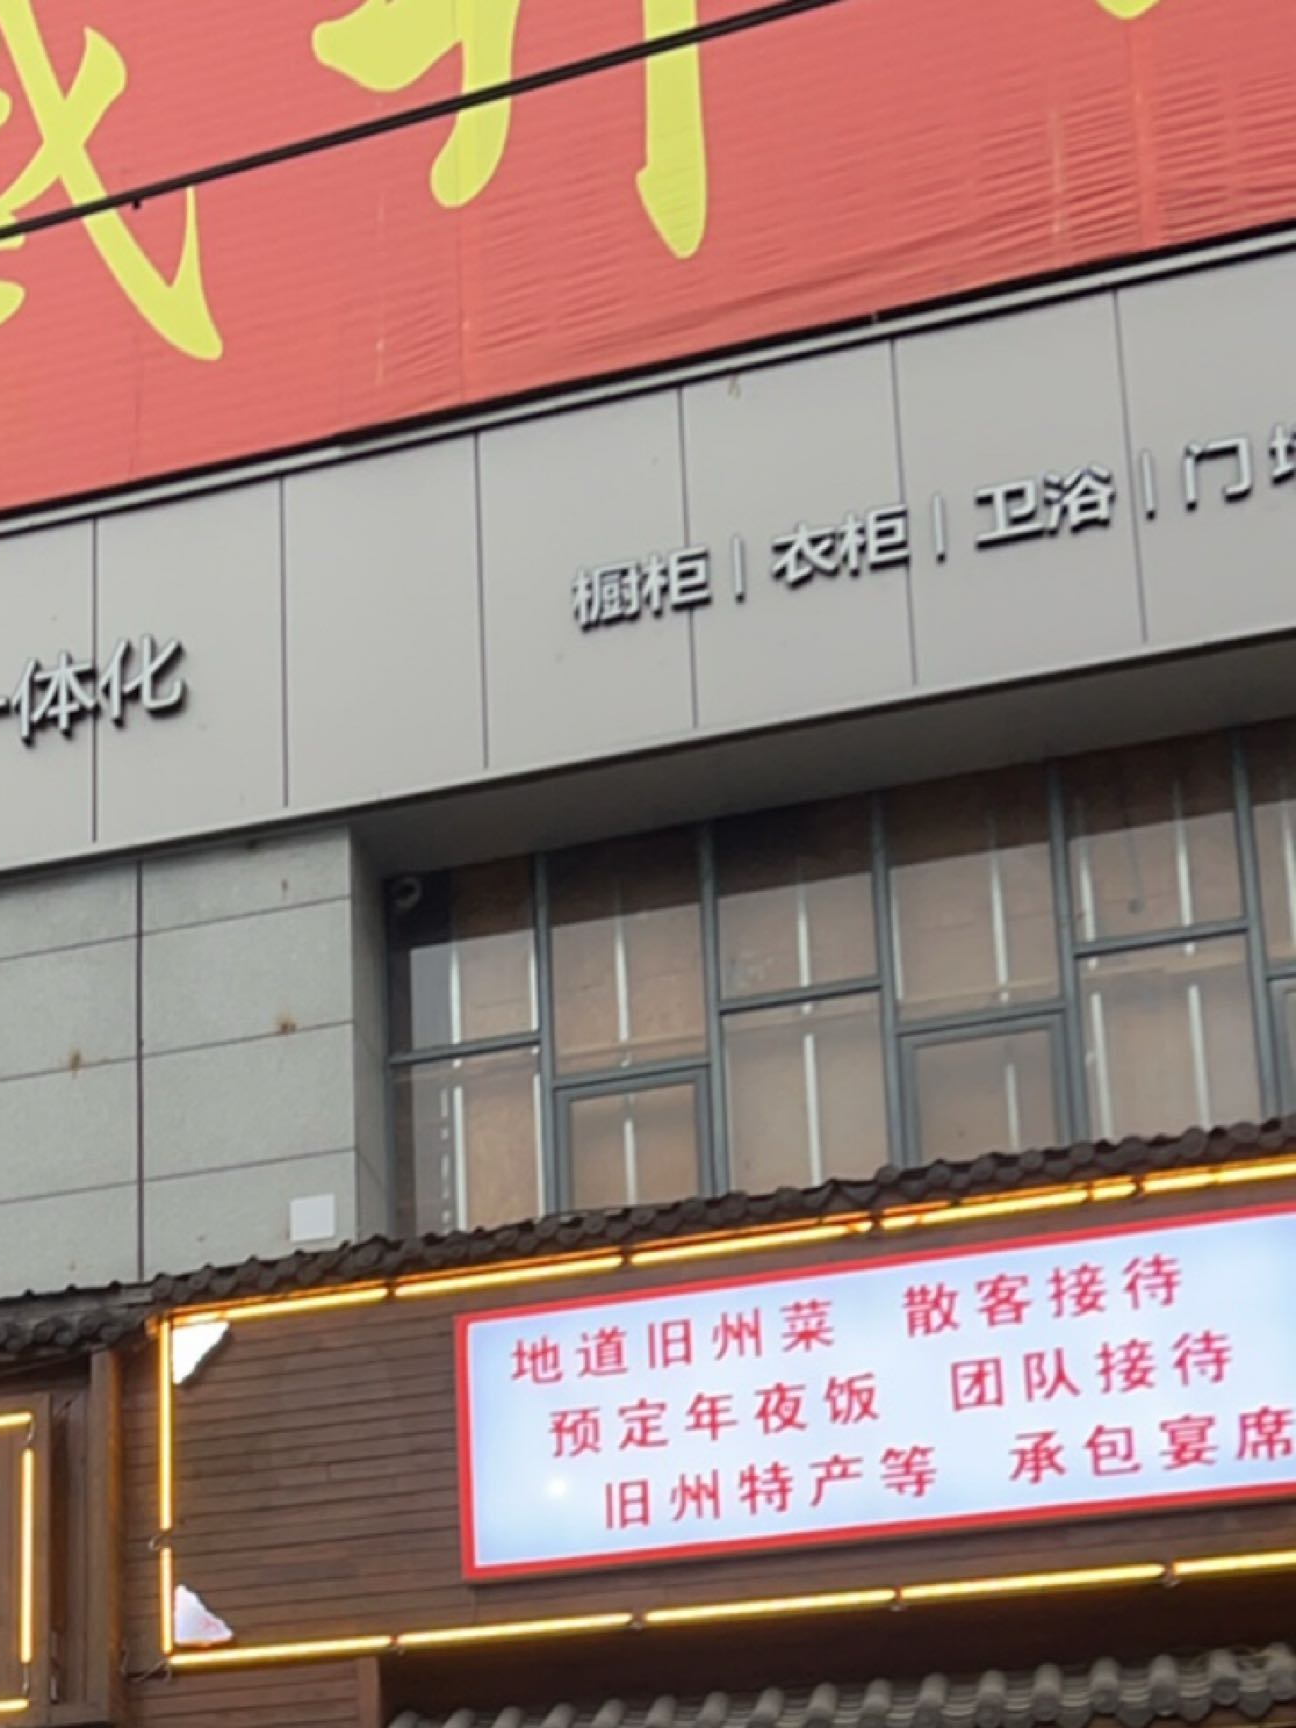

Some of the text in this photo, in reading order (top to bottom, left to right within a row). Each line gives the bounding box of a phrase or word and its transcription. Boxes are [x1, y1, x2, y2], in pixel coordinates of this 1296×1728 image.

[571, 545, 710, 630] 橱柜
[771, 505, 908, 586] 衣柜
[975, 465, 1115, 551] 卫浴
[510, 1252, 1182, 1387] 地道旧州菜 散客接待
[548, 1329, 1233, 1460] 预定年夜饭 团队接待
[603, 1405, 1296, 1530] 旧州特产等 承包宴席
